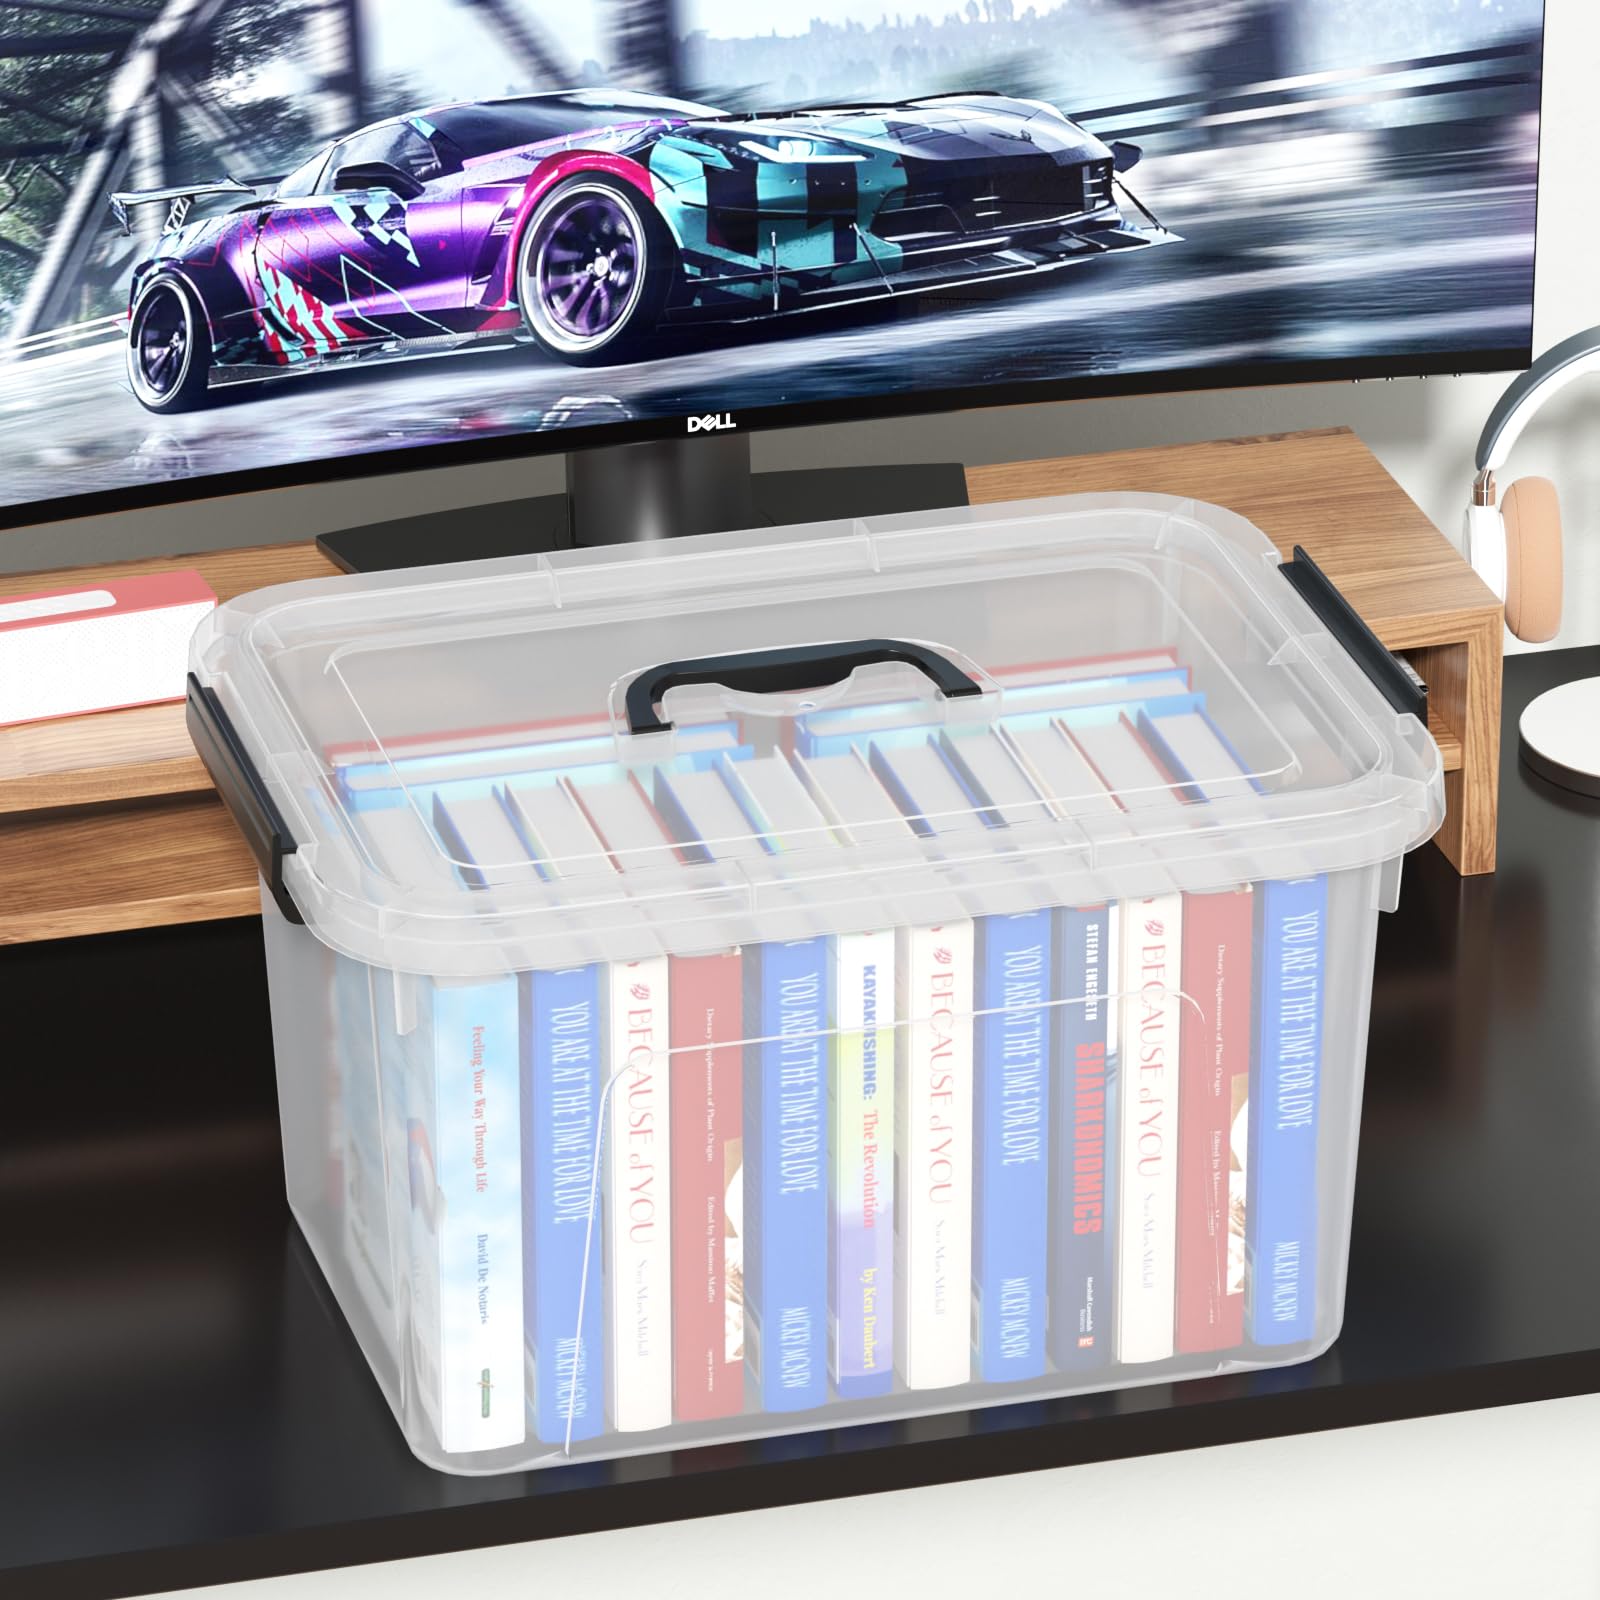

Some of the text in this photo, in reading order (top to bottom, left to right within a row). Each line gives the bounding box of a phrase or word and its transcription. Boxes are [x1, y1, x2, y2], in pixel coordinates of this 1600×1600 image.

[687, 413, 737, 433] DELL
[1086, 924, 1099, 964] STEFAN
[1277, 910, 1320, 1129] YOU ARE AT THE TIME FOR LOVE
[470, 1026, 489, 1192] Feeling Your Way Through Life
[551, 1000, 592, 1225] YOU ARE AT THE TIME FOR LOVE
[628, 1008, 655, 1243] BECAUSE of YOU
[704, 1042, 715, 1096] upplements
[779, 972, 819, 1194] YOU ARE AT THE TIME FOR LOVE
[862, 964, 879, 1229] KAYAKISHING: The Revolution
[929, 971, 954, 1204] BECAUSE of YOU
[1002, 944, 1043, 1165] YOU ARE AT THE TIME FOR LOVE
[1073, 1041, 1106, 1236] SHARKONOMICS
[1138, 944, 1166, 1177] BECAUSE of YOU
[477, 1233, 491, 1324] David De Notaris
[780, 1306, 812, 1388] MICKEY MCNEW
[858, 1267, 879, 1369] by Ken Daubert
[1000, 1277, 1030, 1359] MICKEY MCNEW
[1272, 1240, 1300, 1321] MICKEY MCNEW
